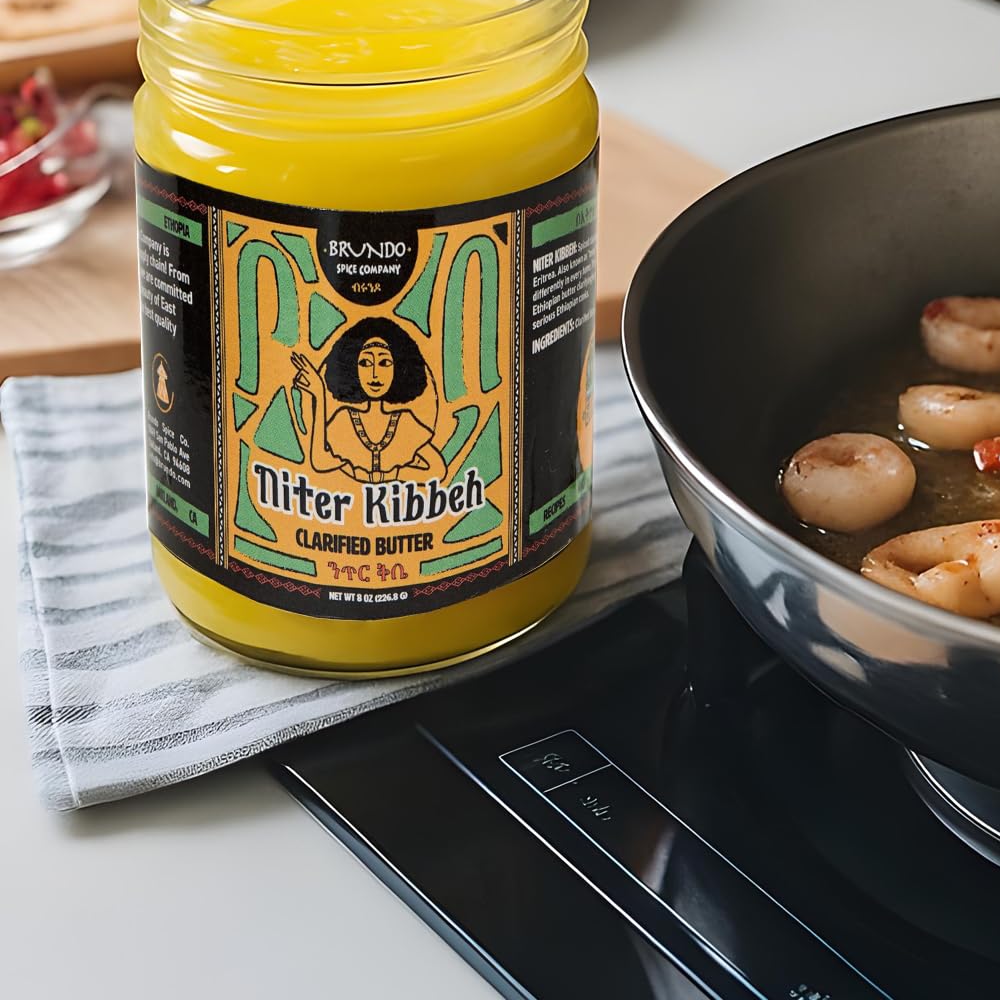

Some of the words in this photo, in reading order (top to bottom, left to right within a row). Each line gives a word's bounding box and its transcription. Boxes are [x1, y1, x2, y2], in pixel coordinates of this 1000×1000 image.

[162, 242, 170, 257] is
[329, 240, 406, 259] BRUNDO
[168, 262, 190, 285] From
[336, 263, 357, 275] SPICE
[359, 263, 401, 275] COMPANY
[532, 252, 554, 274] NITER
[533, 271, 557, 288] Eritrea.
[557, 263, 569, 276] Also
[154, 277, 193, 305] committed
[532, 279, 564, 302] differently
[564, 275, 570, 285] in
[160, 295, 177, 316] East
[532, 294, 561, 316] Ethiopian
[532, 311, 556, 330] serious
[556, 297, 579, 317] Ethiopian
[154, 313, 177, 337] quality
[532, 317, 575, 355] INGREDIENTS:
[179, 433, 190, 448] Co.
[178, 447, 190, 462] Ave
[253, 462, 353, 524] Niter
[363, 468, 485, 526] Kibbeh
[188, 509, 198, 526] CA
[295, 528, 371, 556] CLARIFIED
[375, 532, 434, 556] BUTTER
[328, 591, 343, 601] NET
[344, 591, 356, 602] WT
[356, 593, 363, 602] 8
[363, 594, 374, 603] OZ
[375, 592, 399, 603] (226.8
